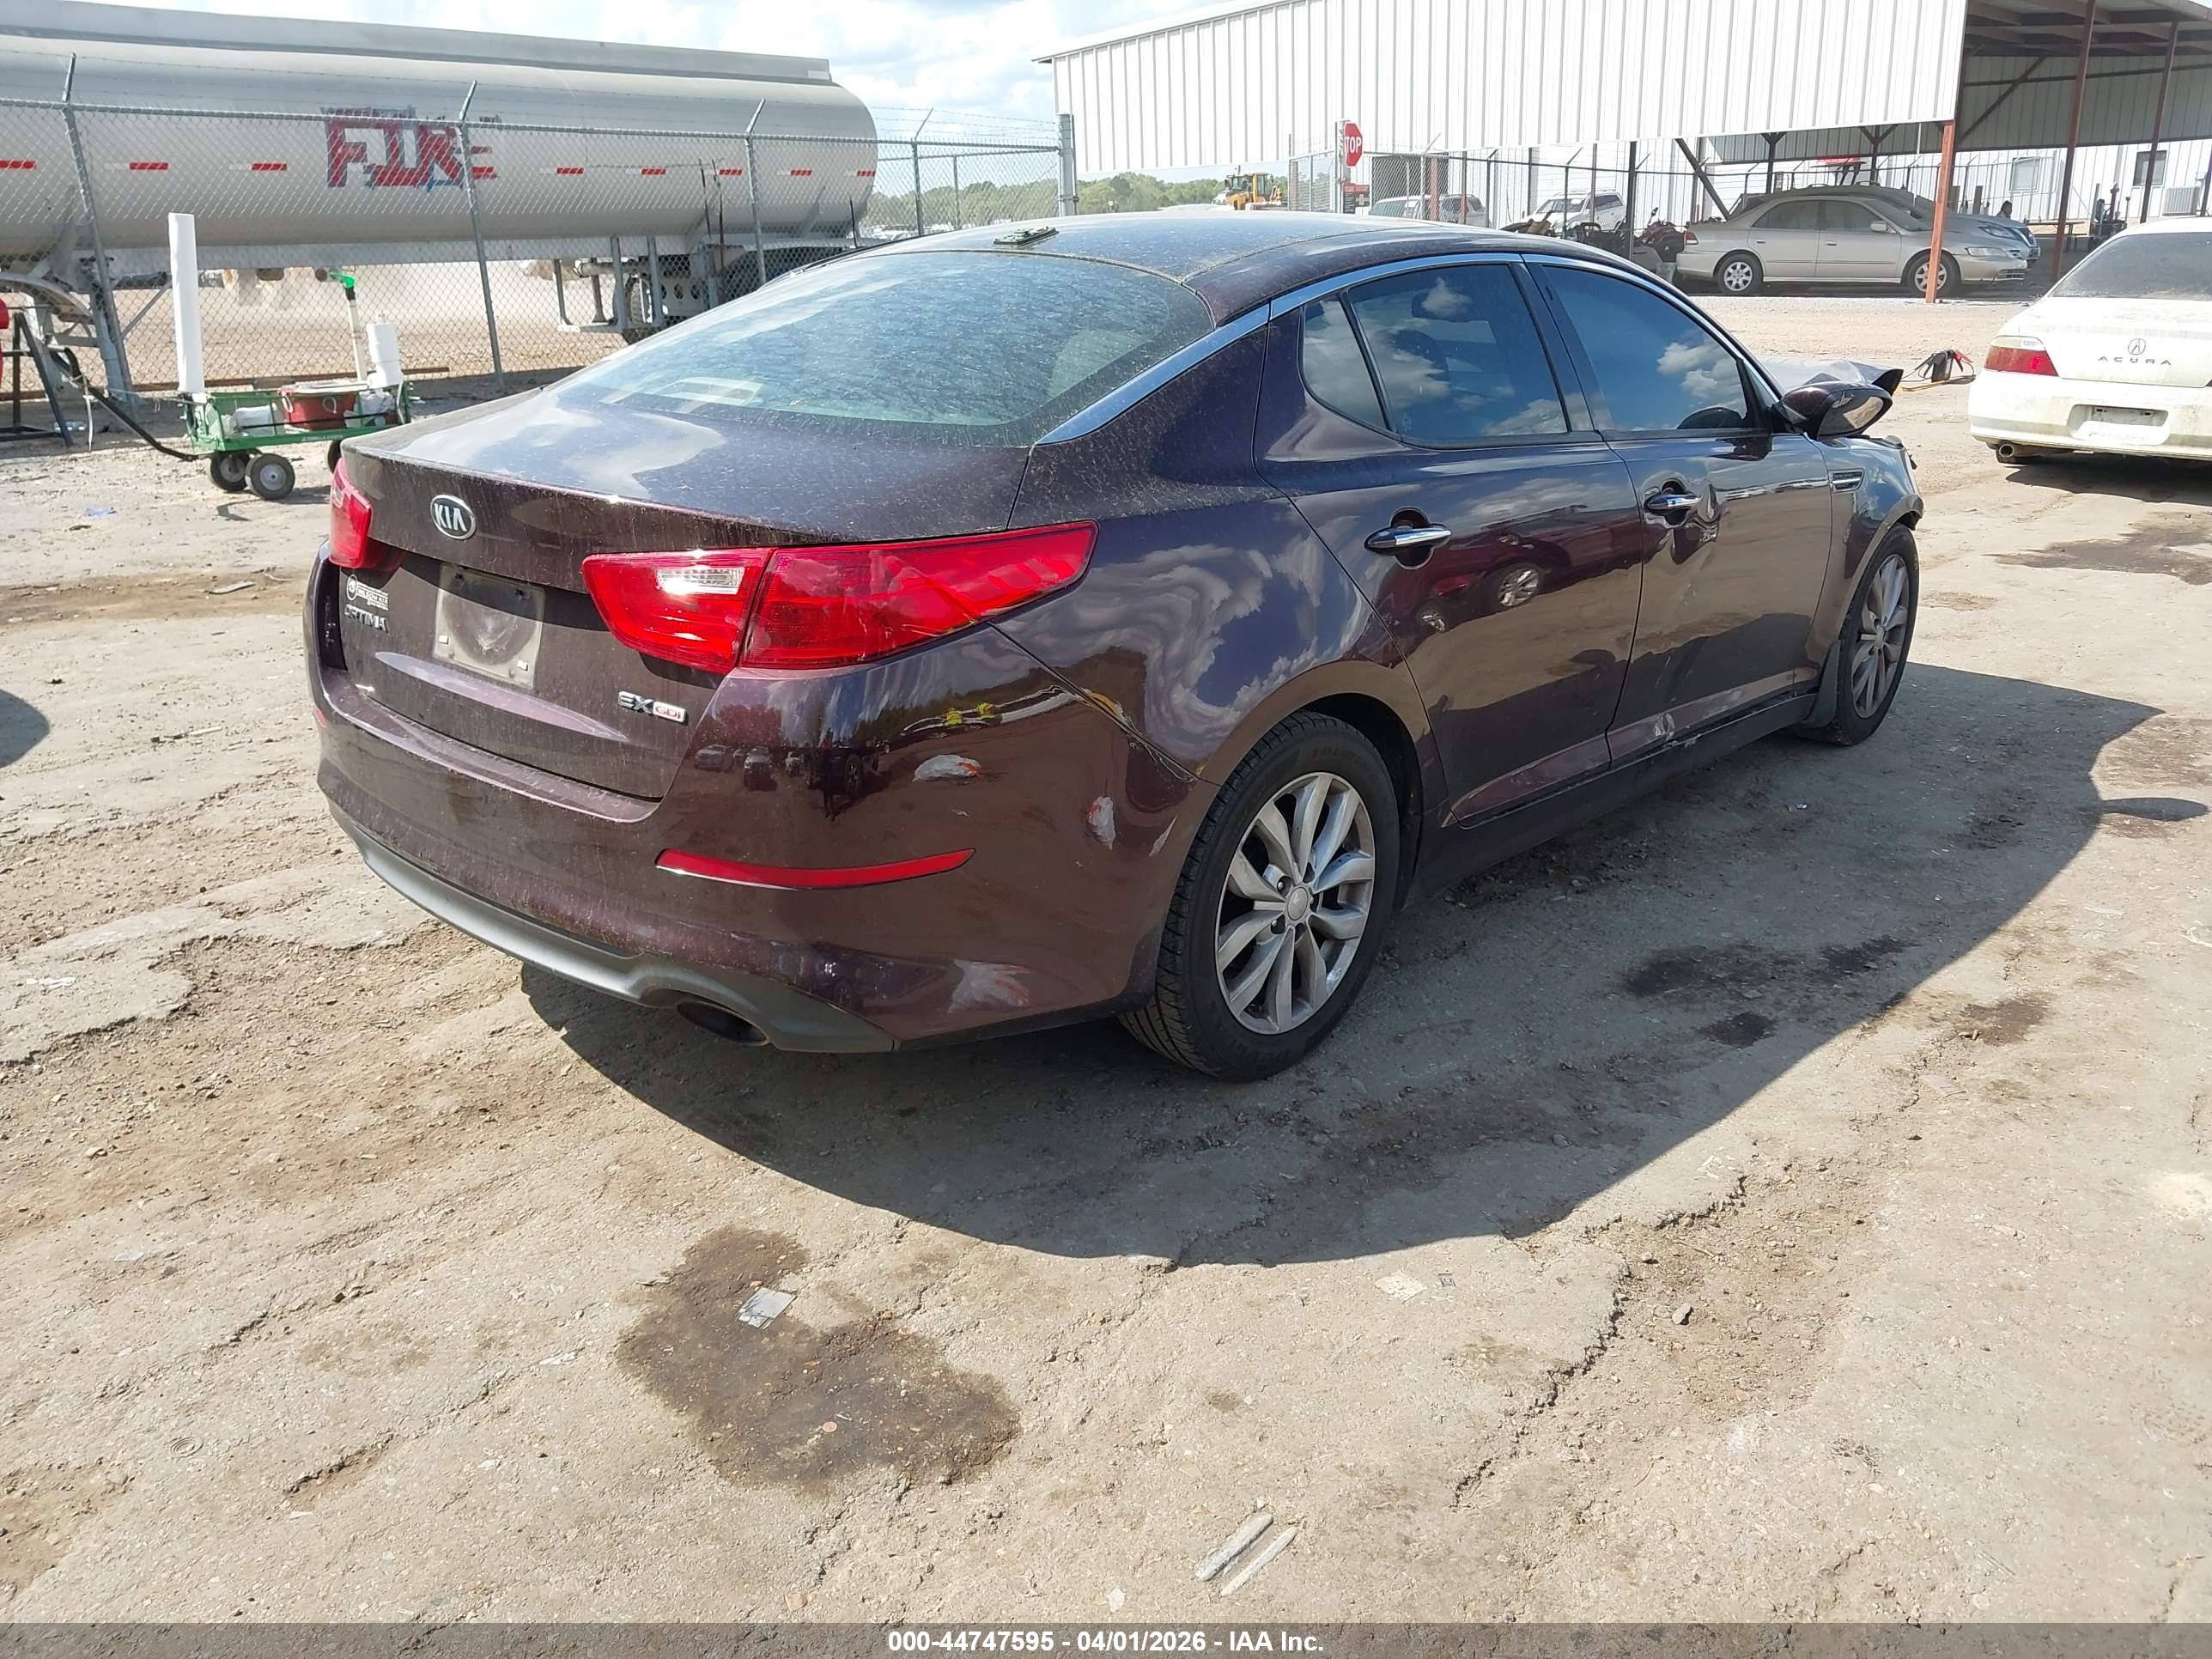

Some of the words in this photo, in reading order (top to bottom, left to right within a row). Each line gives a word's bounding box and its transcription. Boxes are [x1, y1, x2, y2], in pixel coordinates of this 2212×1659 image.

[1346, 136, 1362, 154] TOP
[2098, 356, 2172, 366] ACURA
[434, 502, 468, 532] KIA
[618, 690, 654, 714] EX
